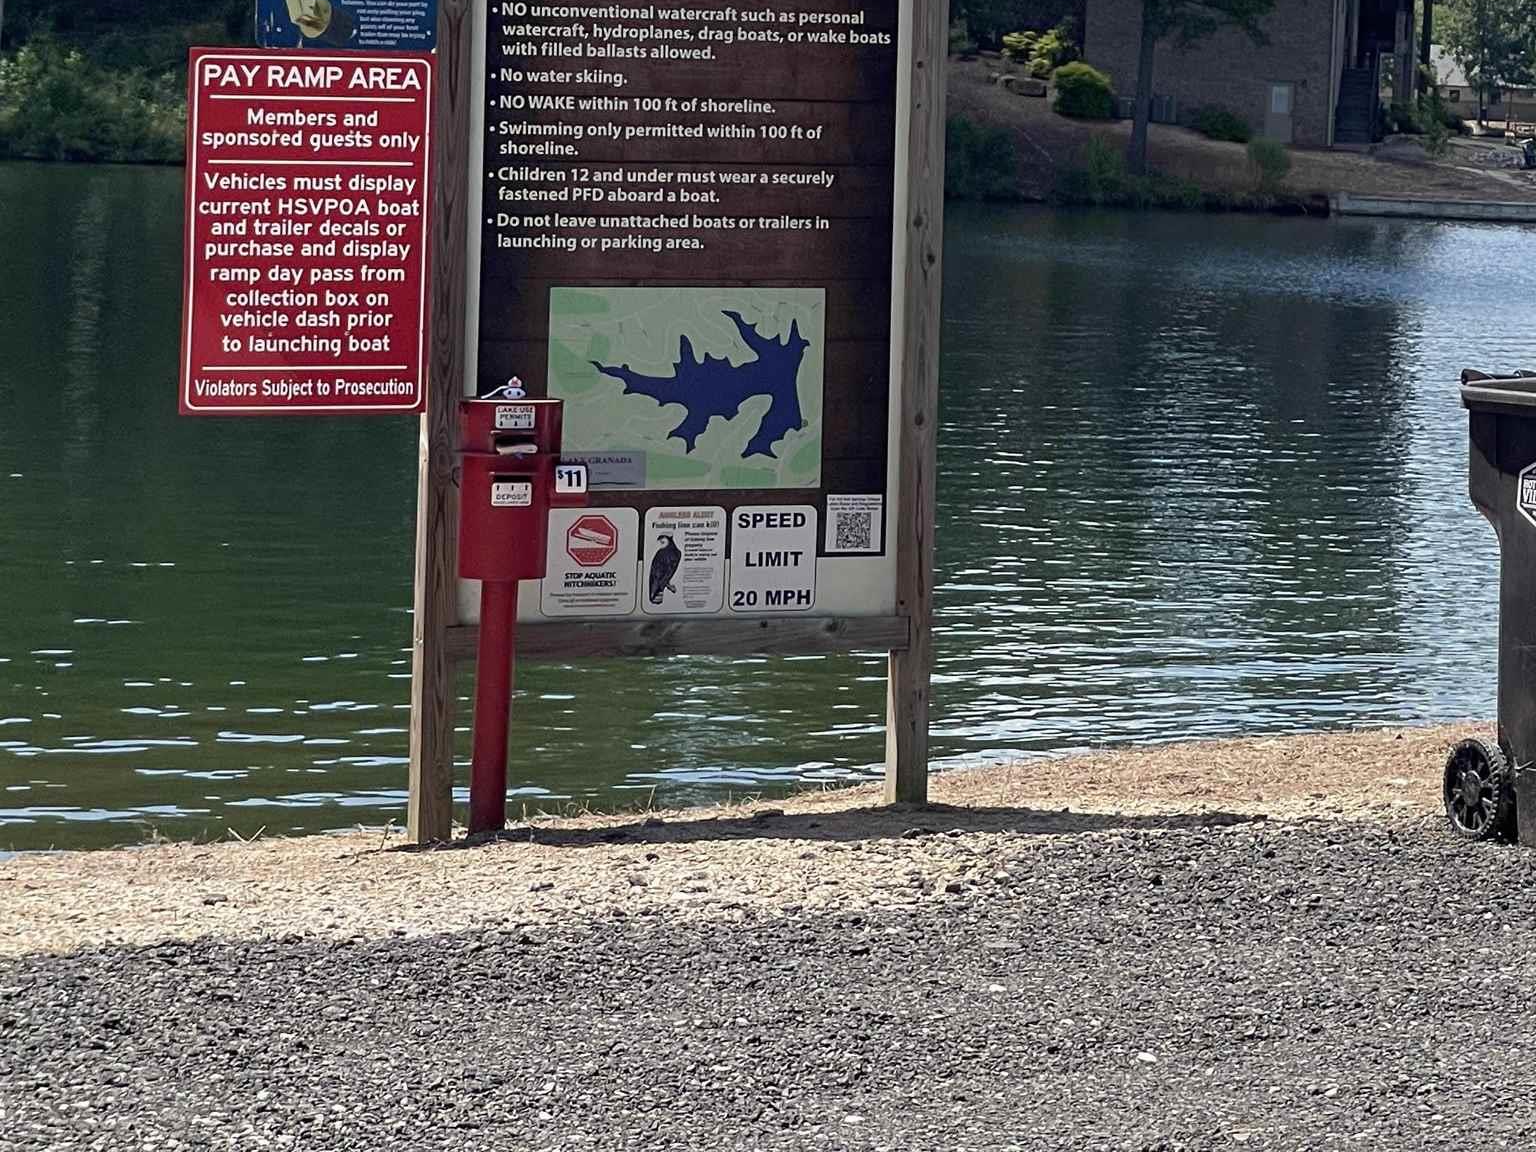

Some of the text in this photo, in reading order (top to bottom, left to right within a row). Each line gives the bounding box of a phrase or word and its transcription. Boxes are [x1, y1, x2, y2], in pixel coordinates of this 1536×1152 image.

[502, 2, 863, 26] NO unconventional watercraft such as personal
[503, 24, 890, 44] watercraft, hydroplanes, drag boats, or wake boats
[502, 42, 715, 59] with filled ballasts allowed.
[204, 64, 421, 90] PAY RAMP AREA
[501, 68, 627, 87] No water skiing.
[248, 108, 377, 126] Members and
[202, 130, 420, 152] sponsored guests only
[204, 172, 416, 194] Vehicles must display
[498, 167, 834, 187] Children 12 and under must wear a securely
[499, 186, 719, 202] fastened PFD aboard a boat.
[199, 198, 419, 216] current HSVPOA boat
[212, 219, 406, 236] and trailer decals or
[206, 240, 410, 260] purchase and display
[211, 265, 404, 285] ramp day pass from
[227, 290, 388, 306] collection box on
[220, 310, 392, 329] vehicle dash prior
[222, 334, 390, 355] to launching boat
[195, 378, 413, 398] Violators Subject to Prosecution
[588, 455, 633, 465] GRANADA
[557, 469, 582, 488] $11
[1523, 479, 1536, 489] HOT
[738, 513, 806, 528] SPEED
[746, 552, 803, 567] LIMIT
[564, 571, 617, 580] STOP AQUATIC
[733, 590, 810, 606] 20 MPH
